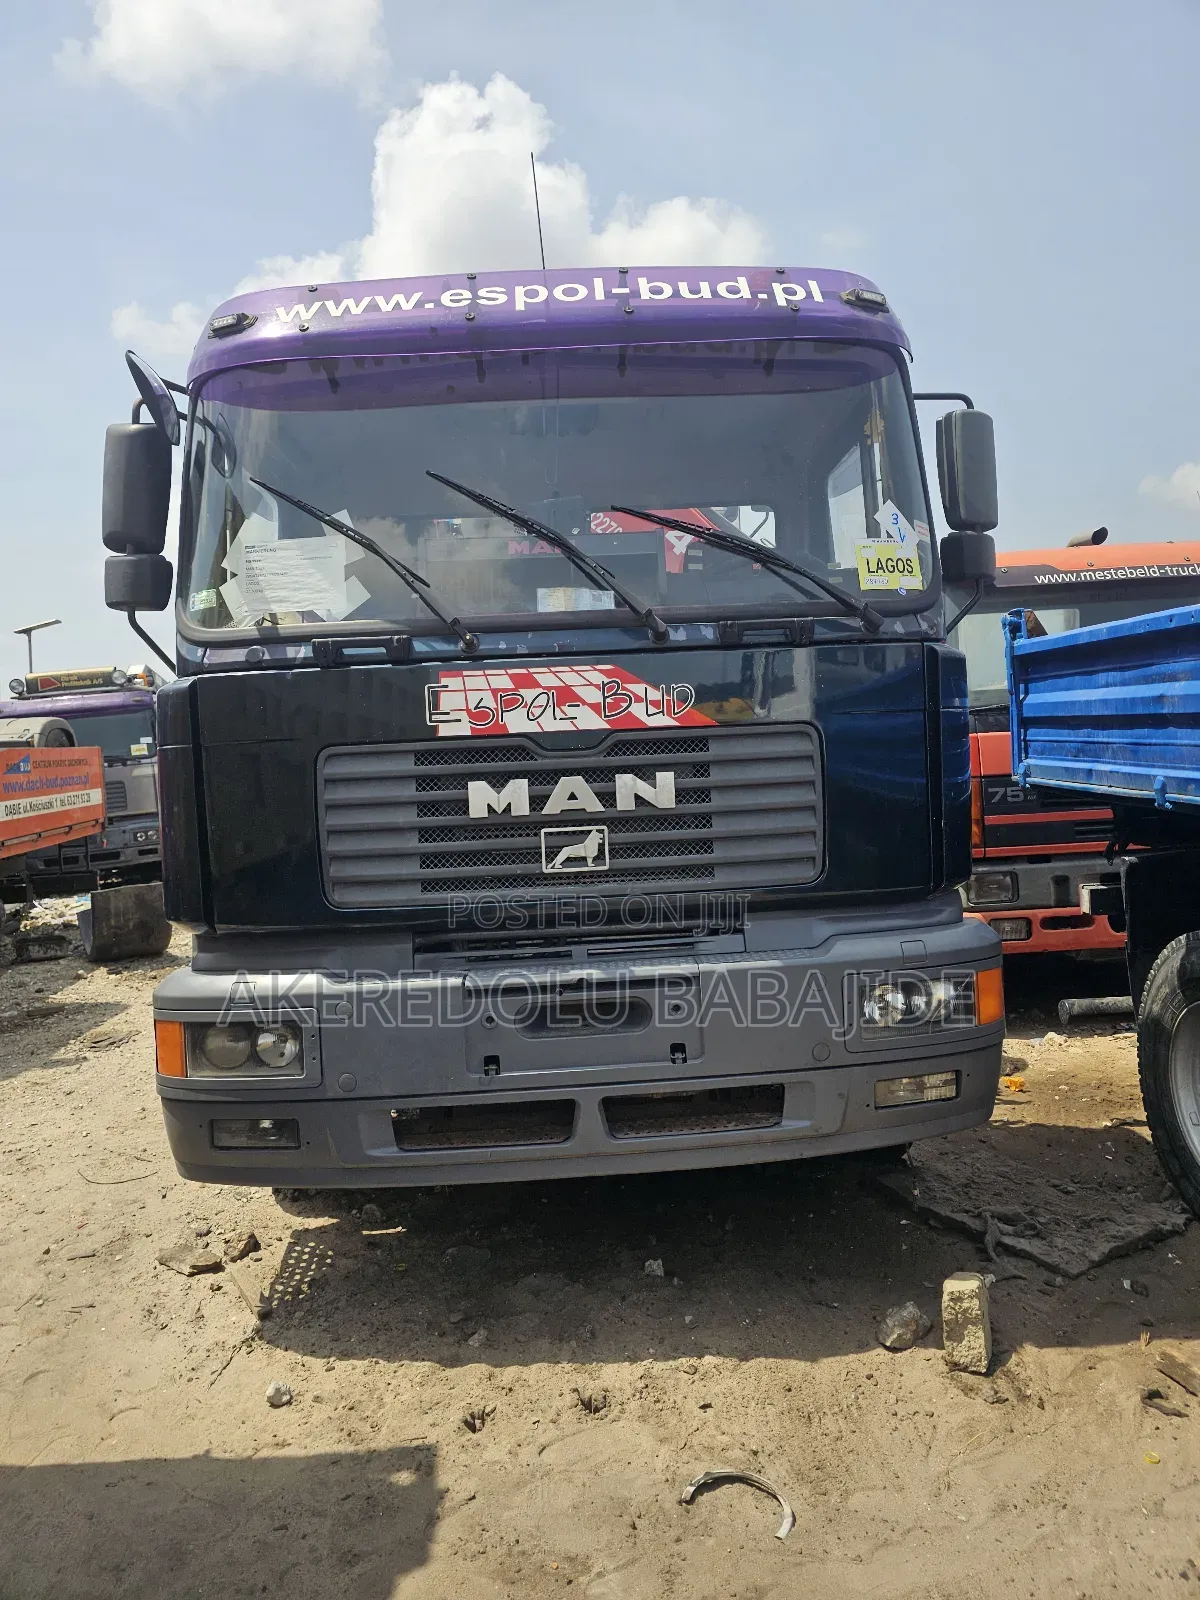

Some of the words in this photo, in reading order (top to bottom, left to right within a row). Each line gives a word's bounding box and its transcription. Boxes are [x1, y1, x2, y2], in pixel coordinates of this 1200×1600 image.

[274, 277, 824, 323] www.espol-bud.pl
[866, 558, 914, 574] LAGOS
[467, 771, 676, 819] MAN
[987, 787, 1025, 803] 75
